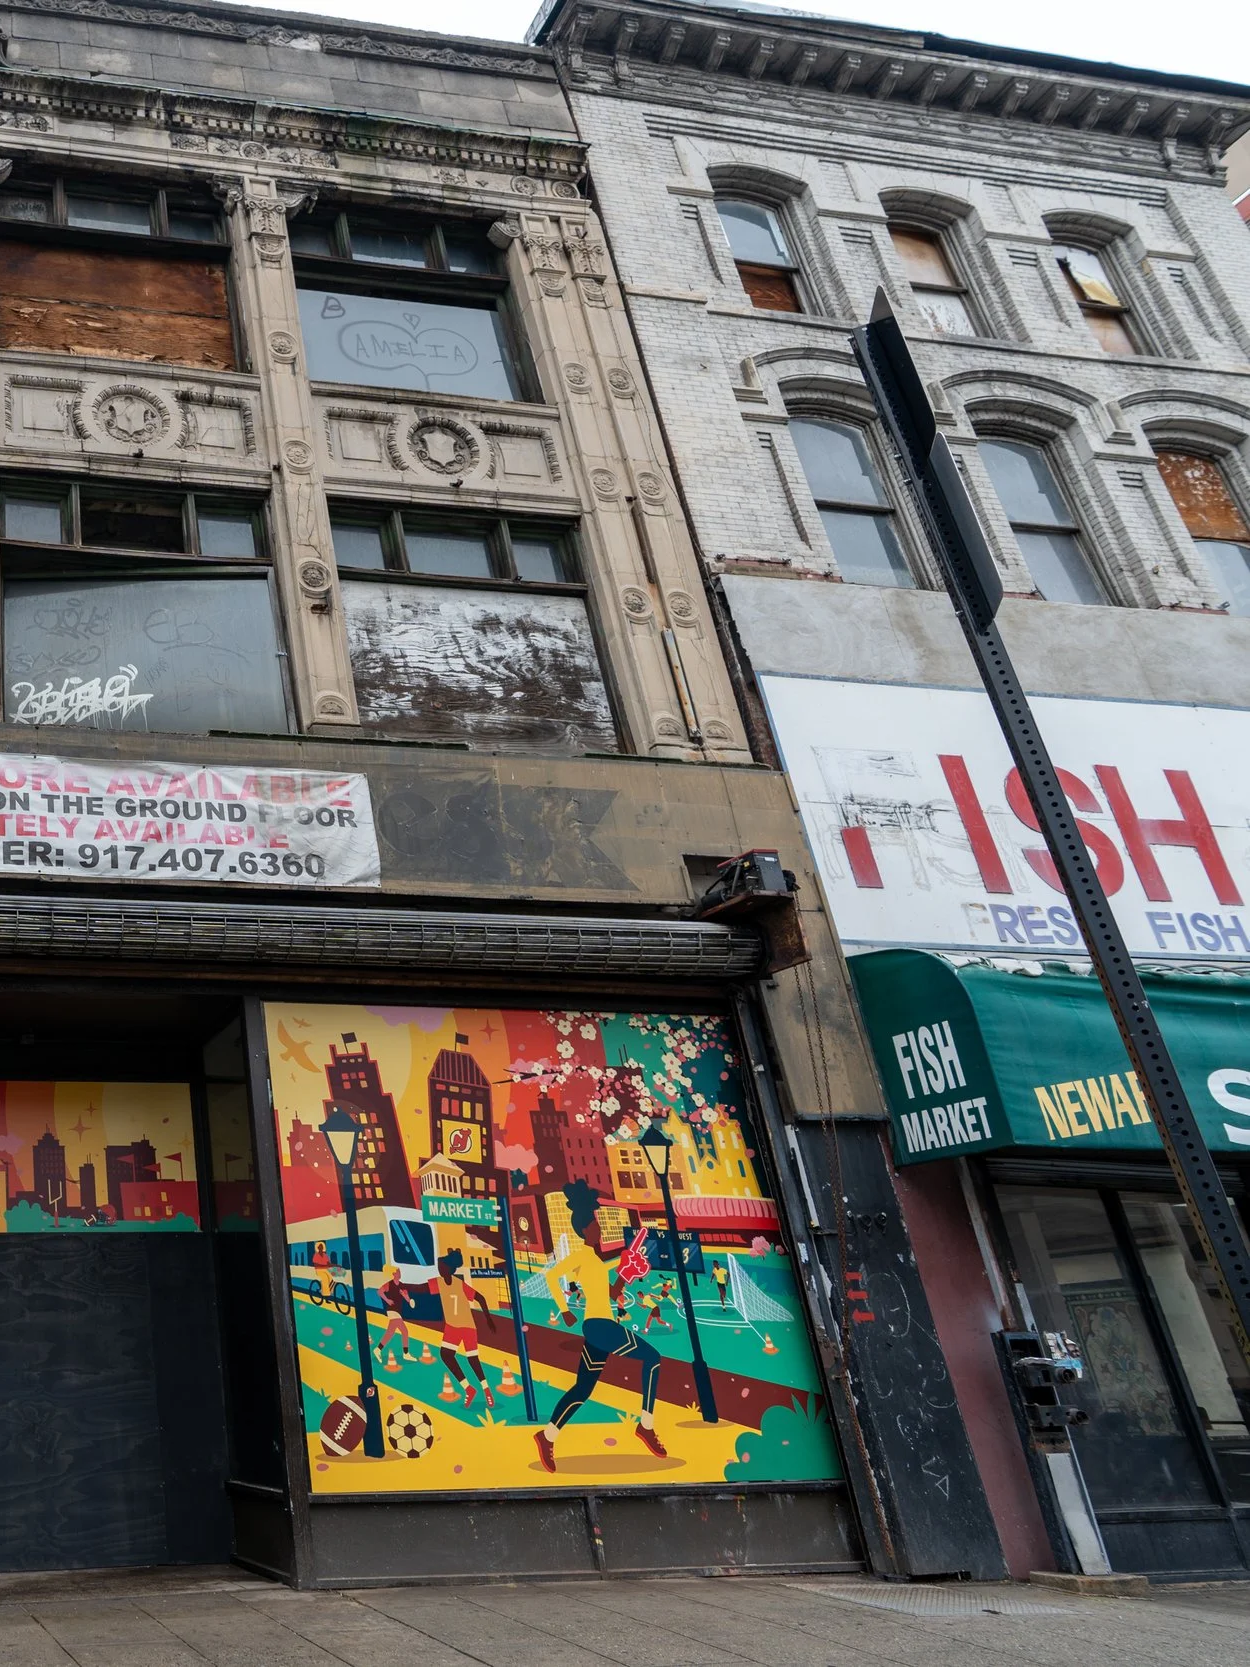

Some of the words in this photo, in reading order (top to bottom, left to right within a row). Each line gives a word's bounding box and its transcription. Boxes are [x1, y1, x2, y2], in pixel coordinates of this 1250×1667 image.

[355, 333, 469, 365] AMELIA
[105, 771, 354, 807] AVAILABLE
[40, 794, 104, 816] THE
[115, 797, 248, 823] GROUND
[258, 803, 358, 829] FLOOR
[93, 819, 290, 849] AVAILABLE
[77, 843, 326, 878] 917.407.6360
[961, 902, 1079, 947] FRES
[1145, 910, 1250, 953] FISH
[892, 1020, 967, 1100] FISH
[900, 1096, 993, 1154] MARKET
[428, 1201, 483, 1219] MARKET
